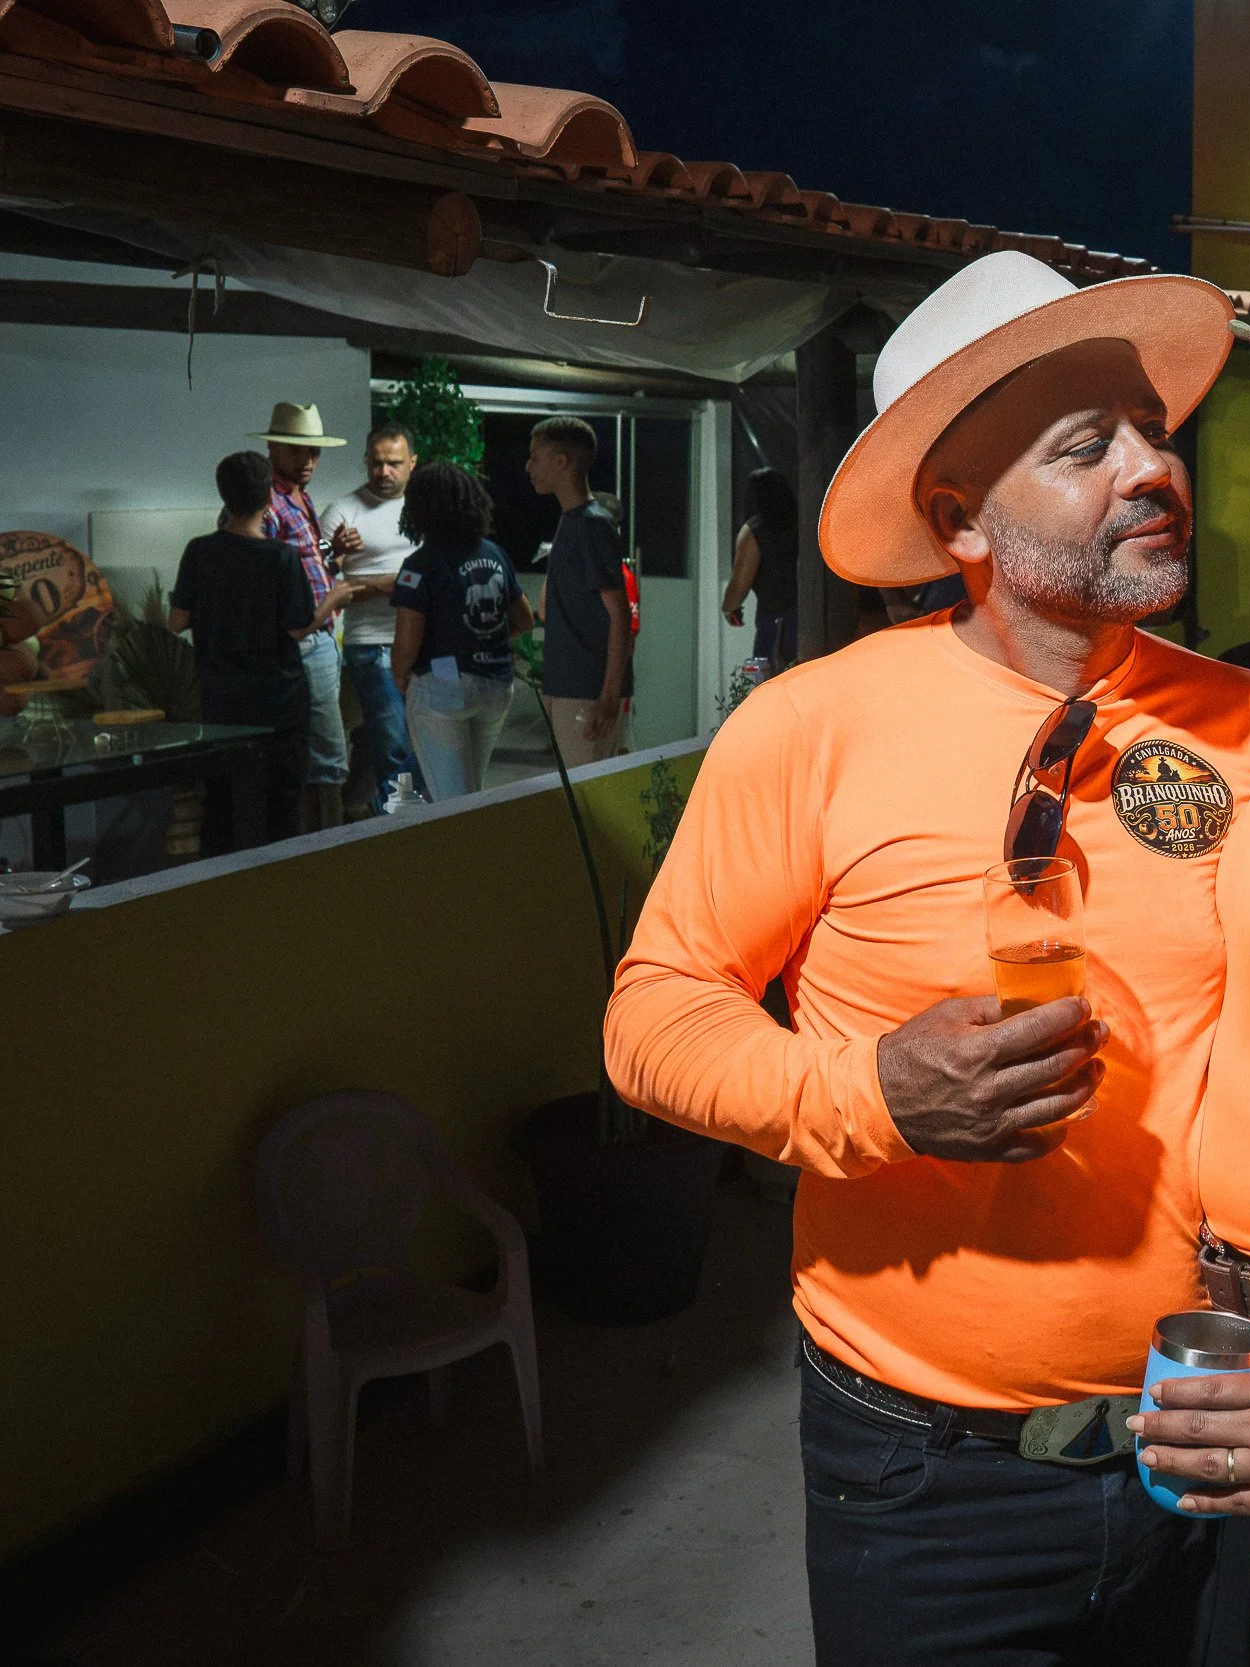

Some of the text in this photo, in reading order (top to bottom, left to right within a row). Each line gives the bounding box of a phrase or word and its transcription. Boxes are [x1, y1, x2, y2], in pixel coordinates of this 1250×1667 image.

[459, 558, 503, 577] COMITIVA
[1136, 746, 1190, 763] CAVALGADA
[1117, 784, 1227, 814] BRANQUINHO
[1154, 803, 1202, 833] 50
[1165, 828, 1197, 842] ANOS
